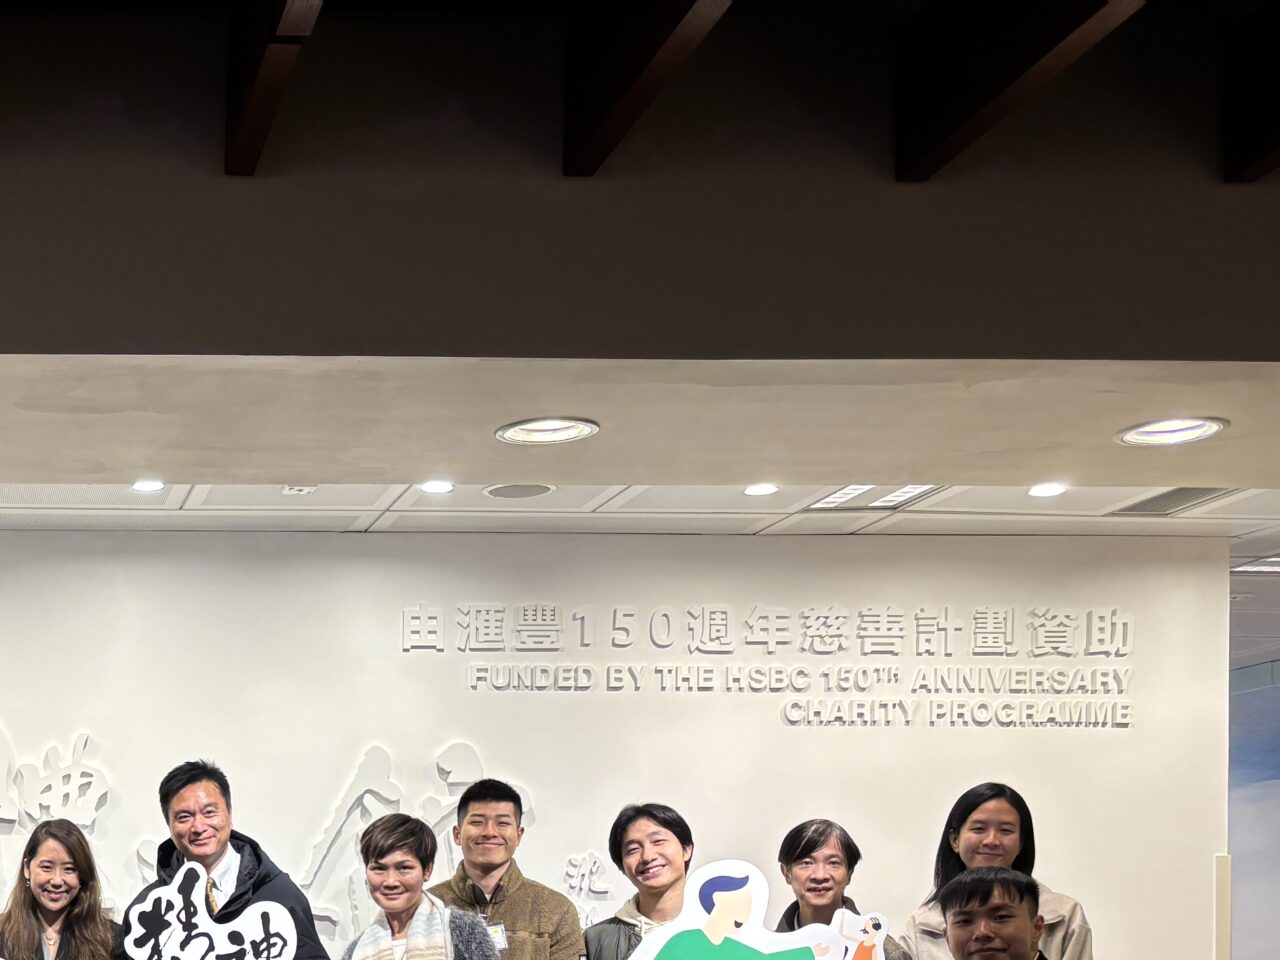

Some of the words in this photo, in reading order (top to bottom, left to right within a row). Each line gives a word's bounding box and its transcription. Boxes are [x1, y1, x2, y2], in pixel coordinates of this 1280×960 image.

[470, 665, 593, 692] FUNDED
[606, 665, 646, 692] BY
[654, 665, 715, 692] THE
[724, 665, 811, 693] HSBC
[910, 667, 1133, 695] ANNIVERSARY
[783, 699, 915, 728] CHARITY
[928, 699, 1135, 729] PROGRAMME
